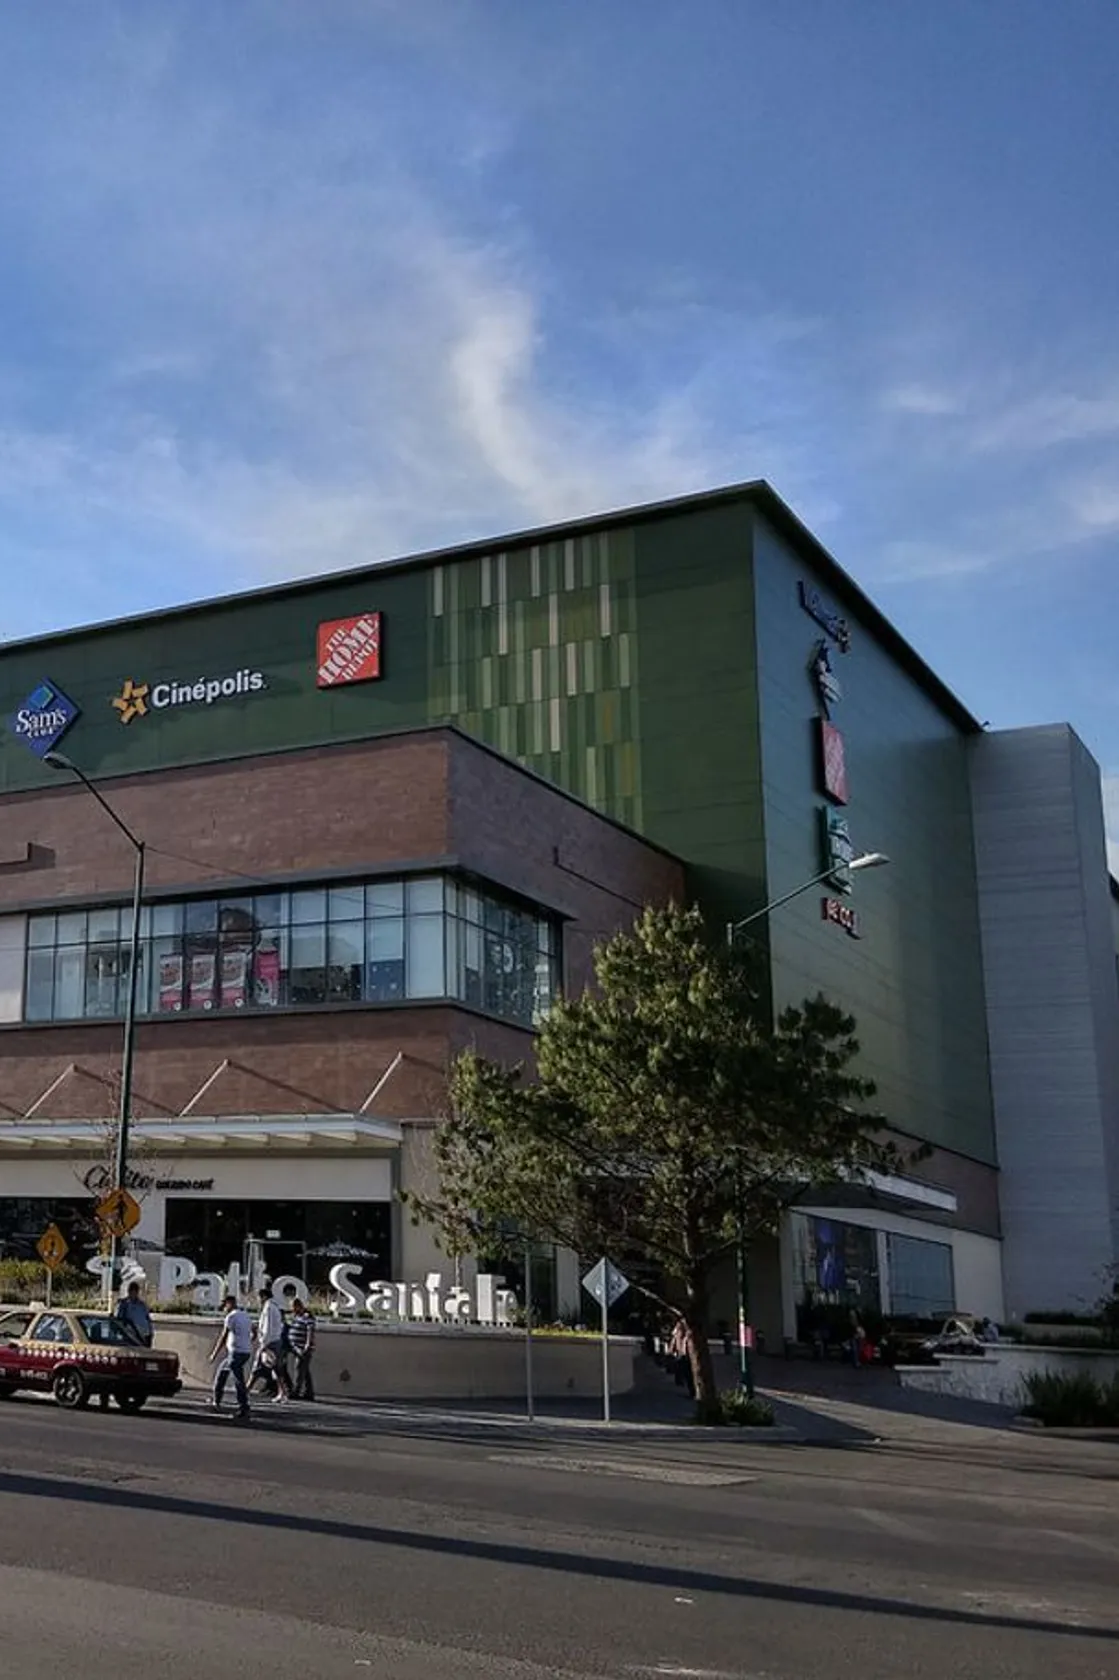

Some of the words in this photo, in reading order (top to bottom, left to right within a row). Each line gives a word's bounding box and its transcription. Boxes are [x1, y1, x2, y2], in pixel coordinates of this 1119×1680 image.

[318, 615, 378, 684] HOME
[326, 628, 347, 652] THE
[342, 638, 378, 680] DEPOT
[151, 668, 264, 708] Cinépolis
[329, 1263, 471, 1320] Santa
